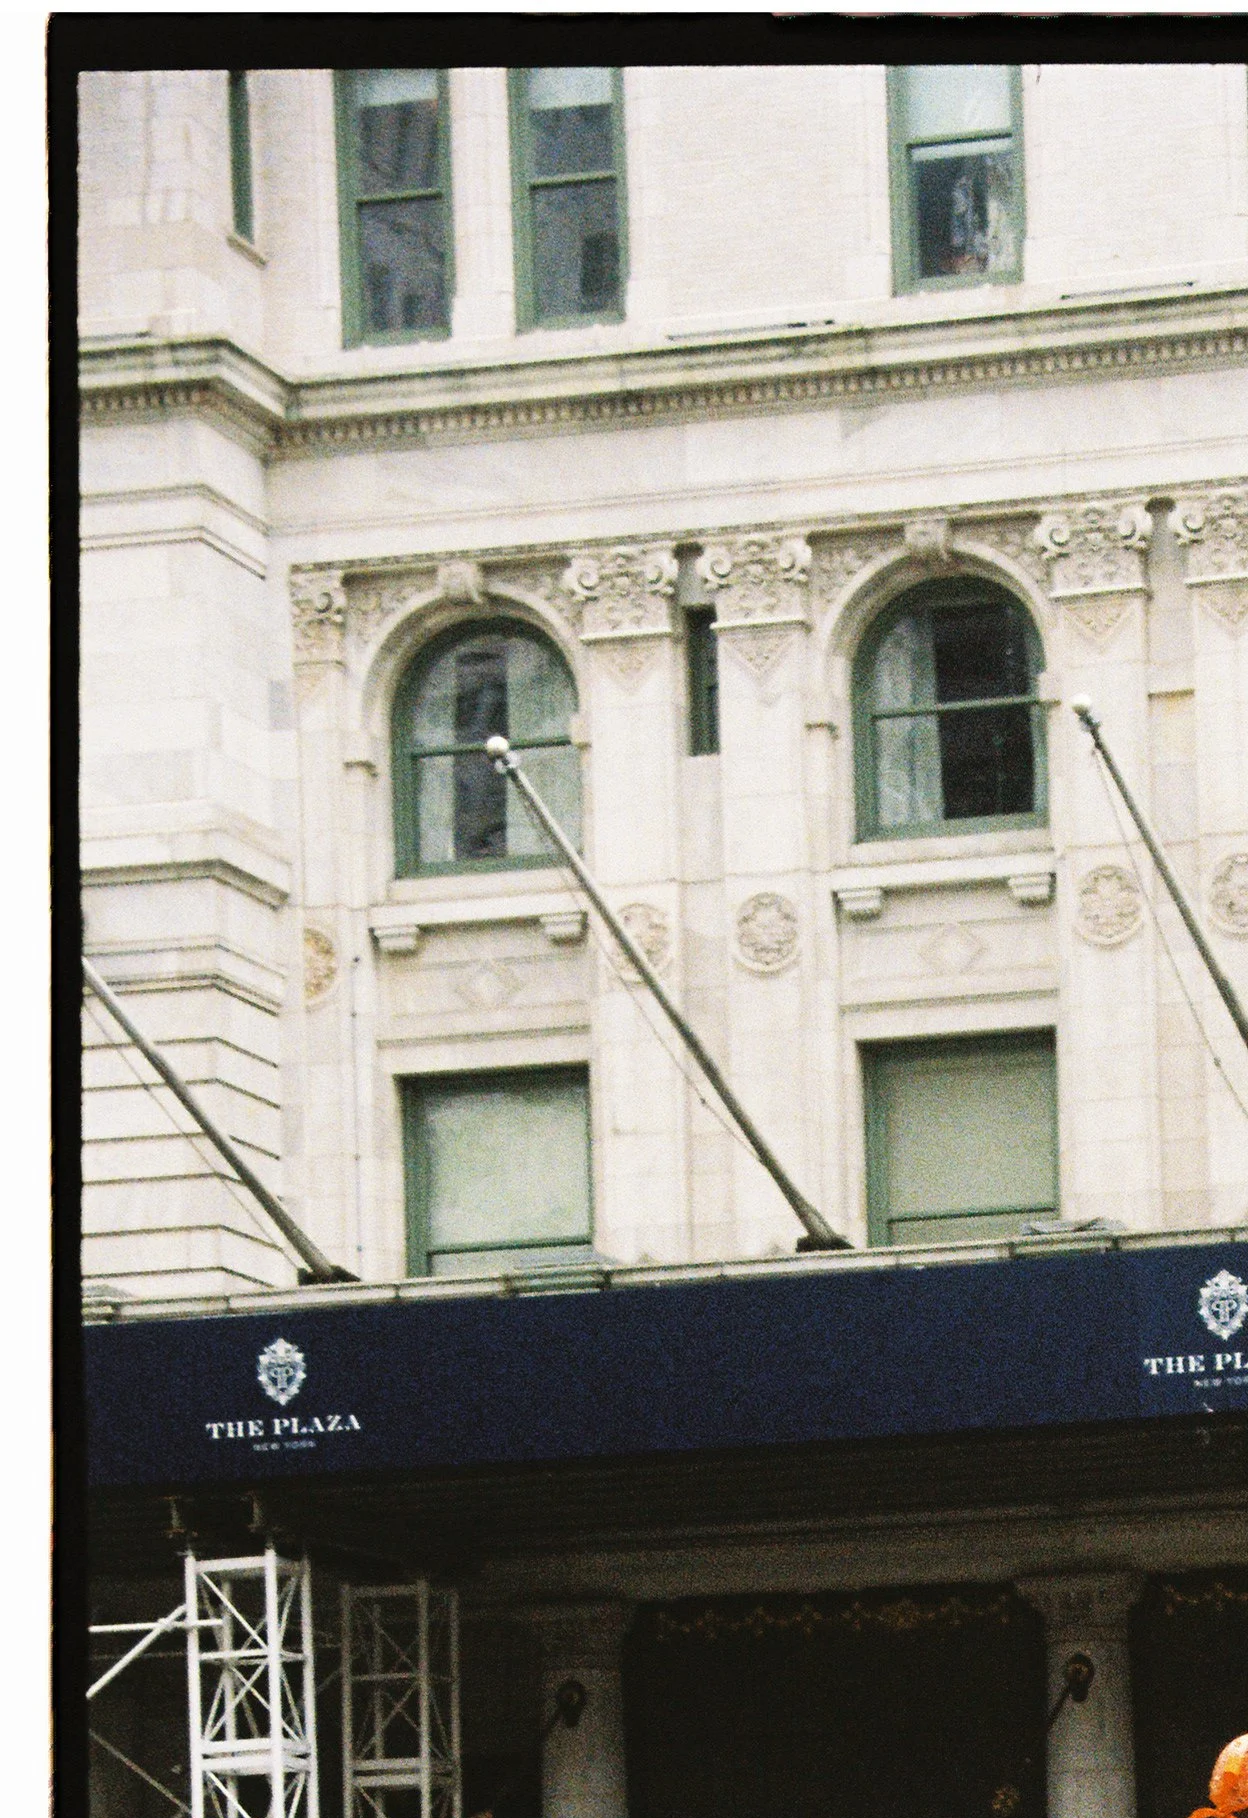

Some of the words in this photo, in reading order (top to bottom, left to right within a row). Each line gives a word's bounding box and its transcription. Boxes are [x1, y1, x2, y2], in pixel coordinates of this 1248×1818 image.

[1143, 1354, 1206, 1376] THE
[205, 1419, 264, 1440] THE
[272, 1413, 362, 1436] PLAZA
